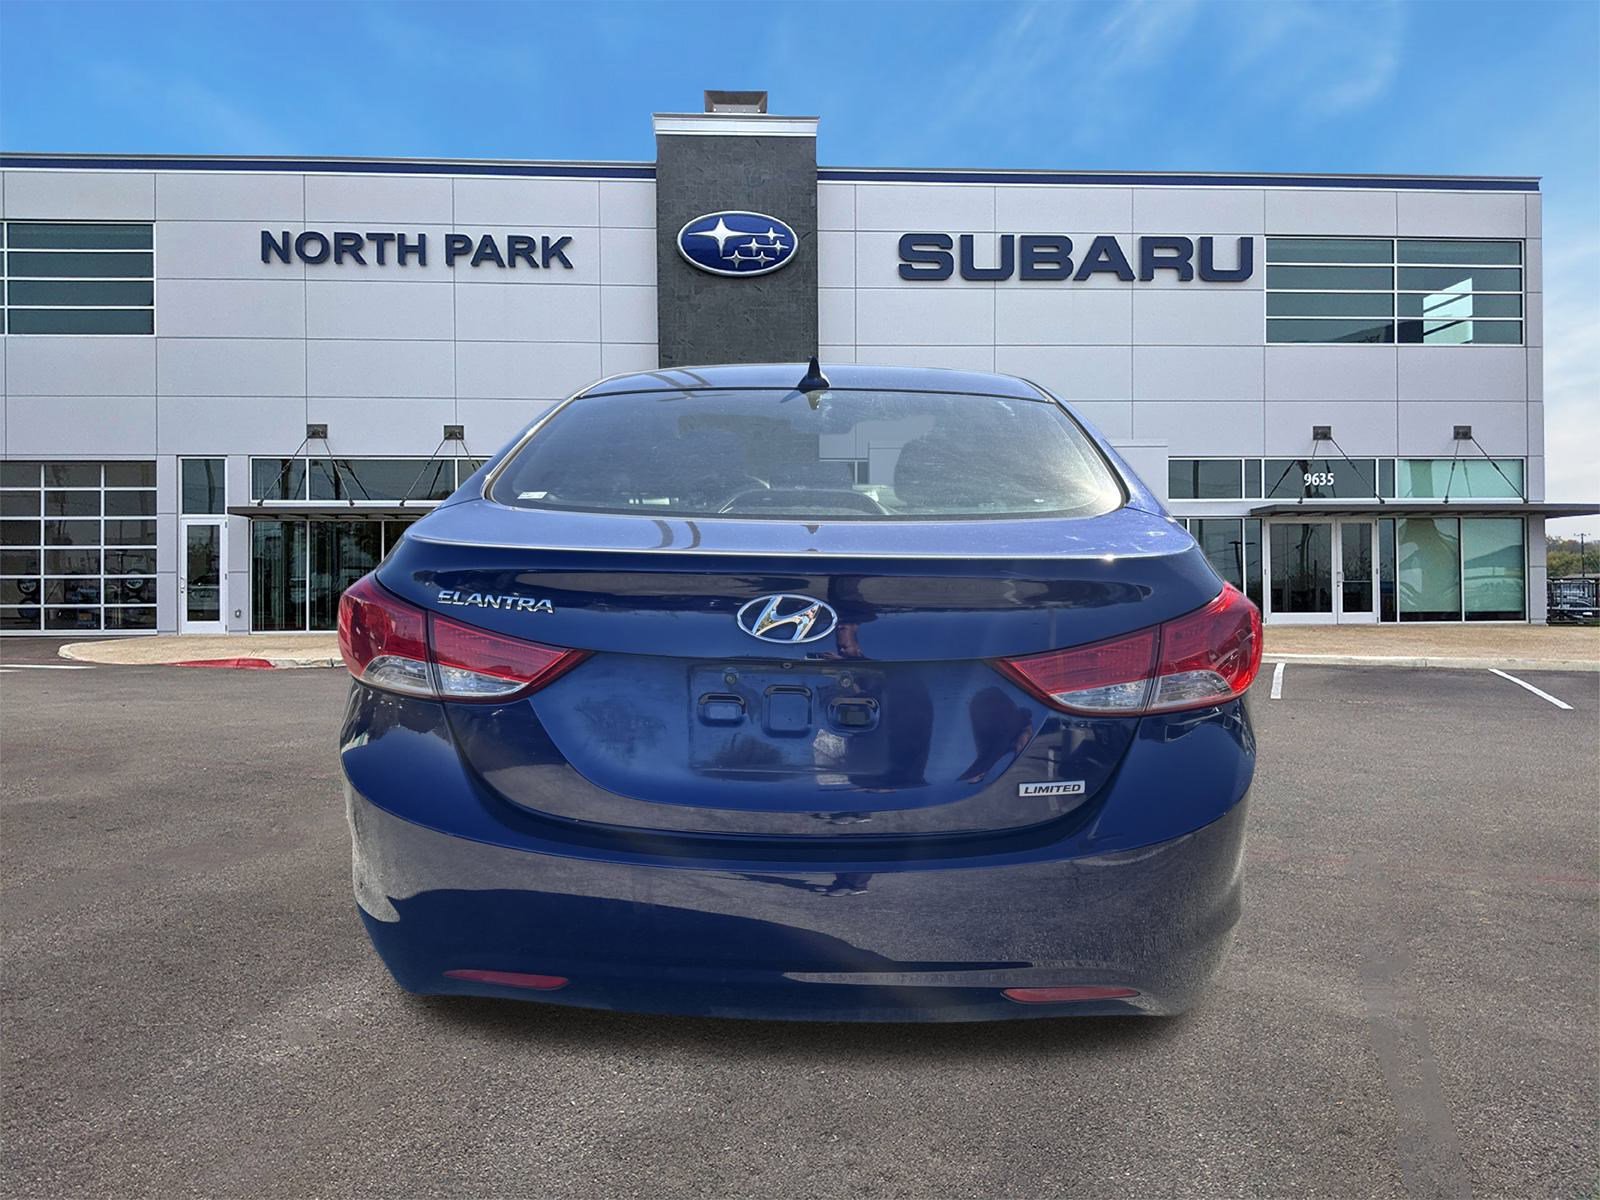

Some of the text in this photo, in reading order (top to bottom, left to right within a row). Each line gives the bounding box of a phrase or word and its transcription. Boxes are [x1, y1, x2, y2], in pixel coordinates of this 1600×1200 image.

[260, 230, 574, 270] NORTH PARK
[898, 232, 1254, 283] SUBARU
[1303, 472, 1335, 486] 9635
[437, 590, 554, 614] ELANTRA
[1023, 783, 1082, 795] LIMITED
